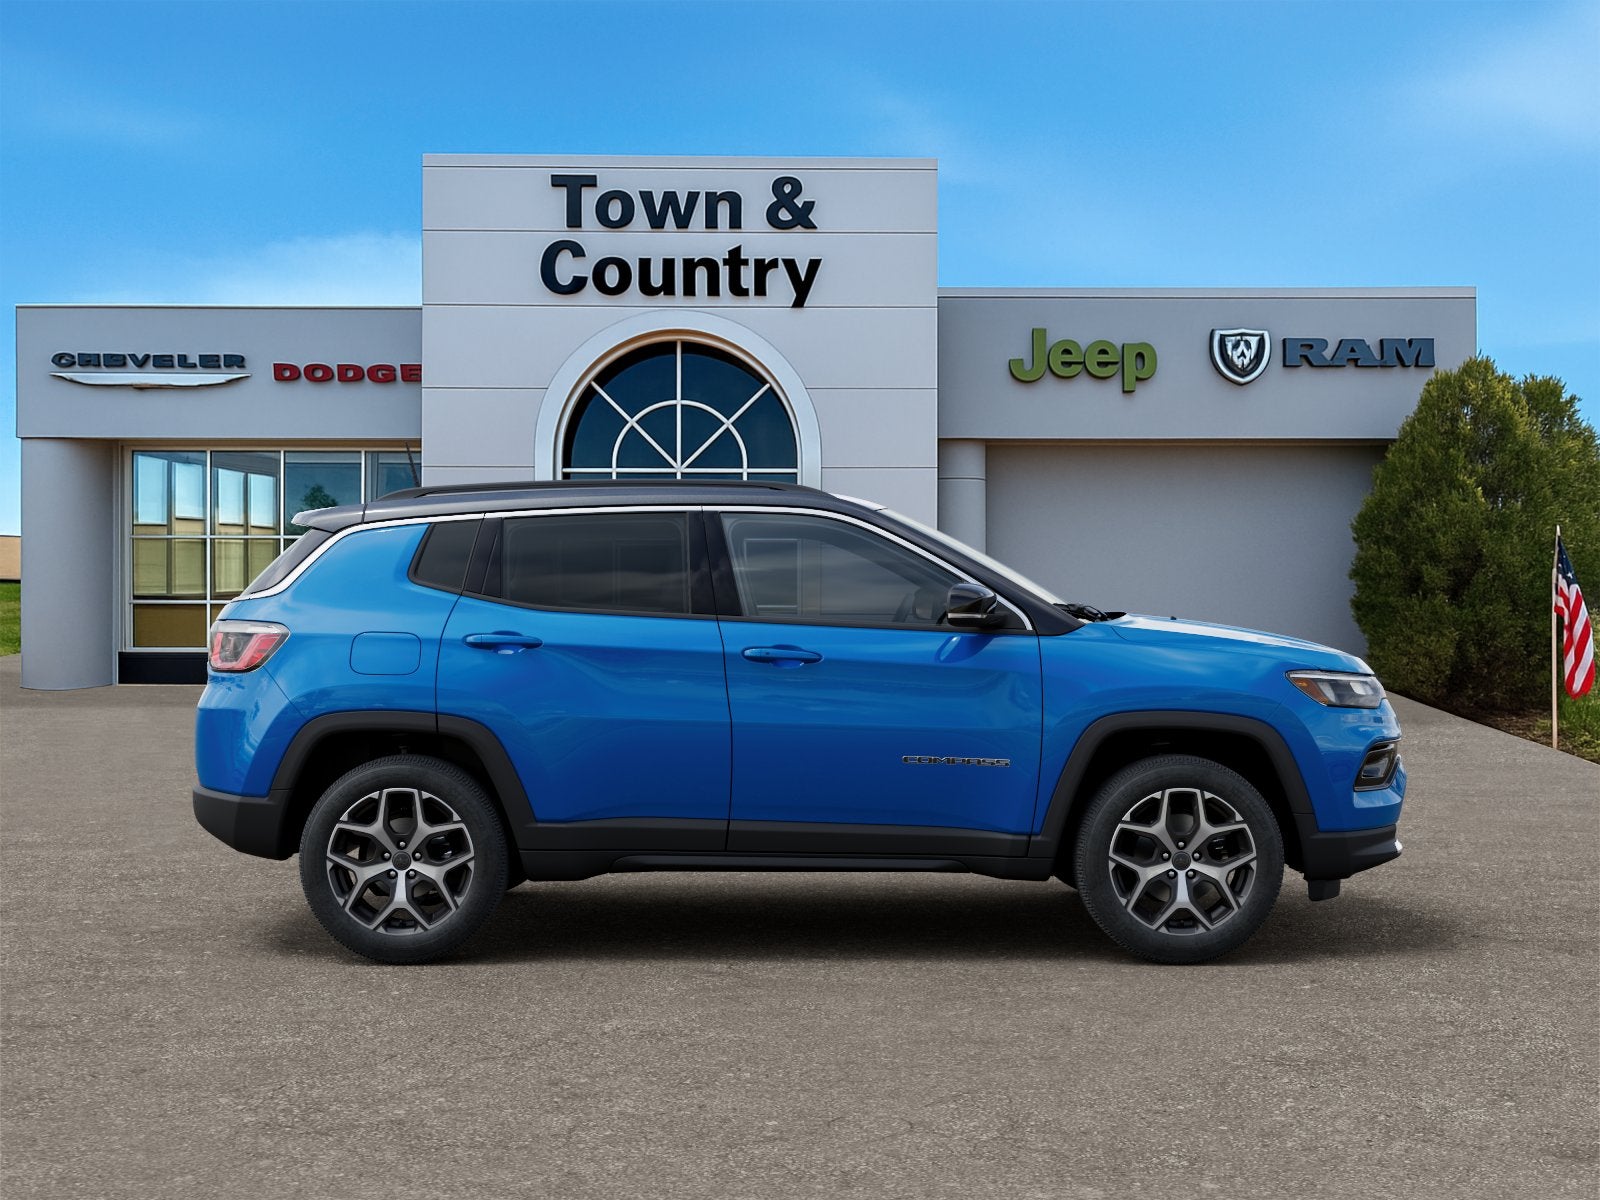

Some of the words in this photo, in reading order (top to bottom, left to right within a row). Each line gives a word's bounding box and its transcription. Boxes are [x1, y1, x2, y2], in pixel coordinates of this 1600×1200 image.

[550, 174, 742, 230] Town
[765, 175, 818, 230] &
[540, 239, 822, 308] Country
[273, 363, 422, 383] DODGE
[1008, 327, 1158, 393] Jeep
[1283, 337, 1436, 368] RAM
[902, 755, 1011, 768] COMPASS
